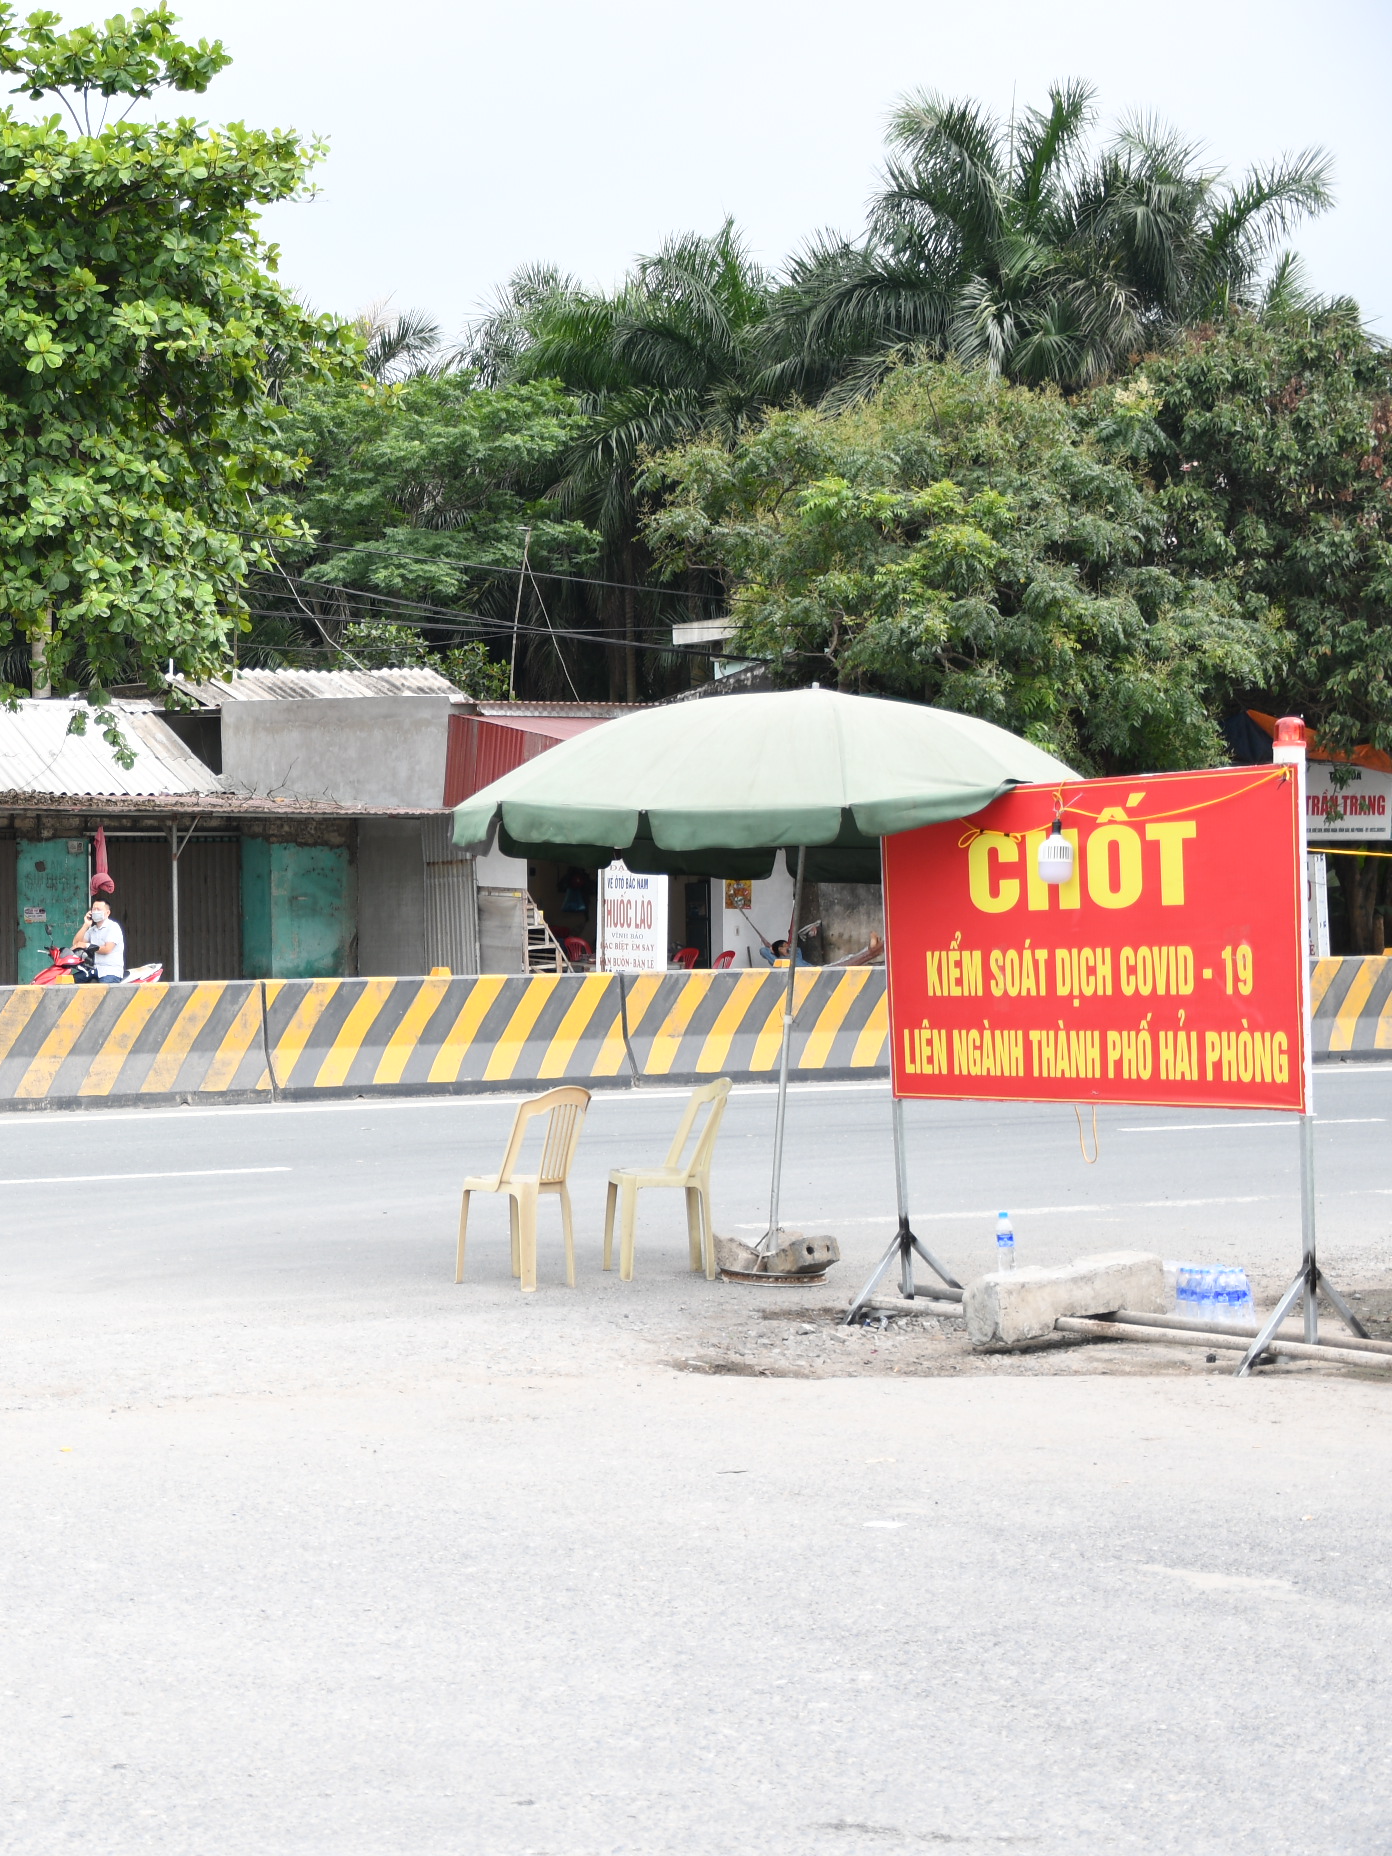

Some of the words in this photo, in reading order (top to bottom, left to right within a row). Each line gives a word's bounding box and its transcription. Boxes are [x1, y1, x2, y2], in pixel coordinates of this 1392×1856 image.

[1341, 795, 1386, 816] TRANG
[969, 792, 1197, 914] CHỐT
[625, 873, 636, 889] BẮC
[636, 878, 649, 889] NAM
[635, 894, 653, 930] LÀO
[642, 943, 655, 952] SAY
[926, 931, 984, 998] KIỂM
[989, 939, 1049, 998] SOÁT
[1055, 945, 1113, 1007] DỊCH
[1120, 945, 1195, 996] COVID
[1221, 944, 1254, 996] 19
[903, 1018, 948, 1075] LIÊN
[953, 1018, 1025, 1078] NGÀNH
[1029, 1018, 1100, 1080] THÀNH
[1106, 1012, 1153, 1081] PHỐ
[1159, 1009, 1199, 1082] HẢI
[1206, 1018, 1289, 1084] PHÒNG
